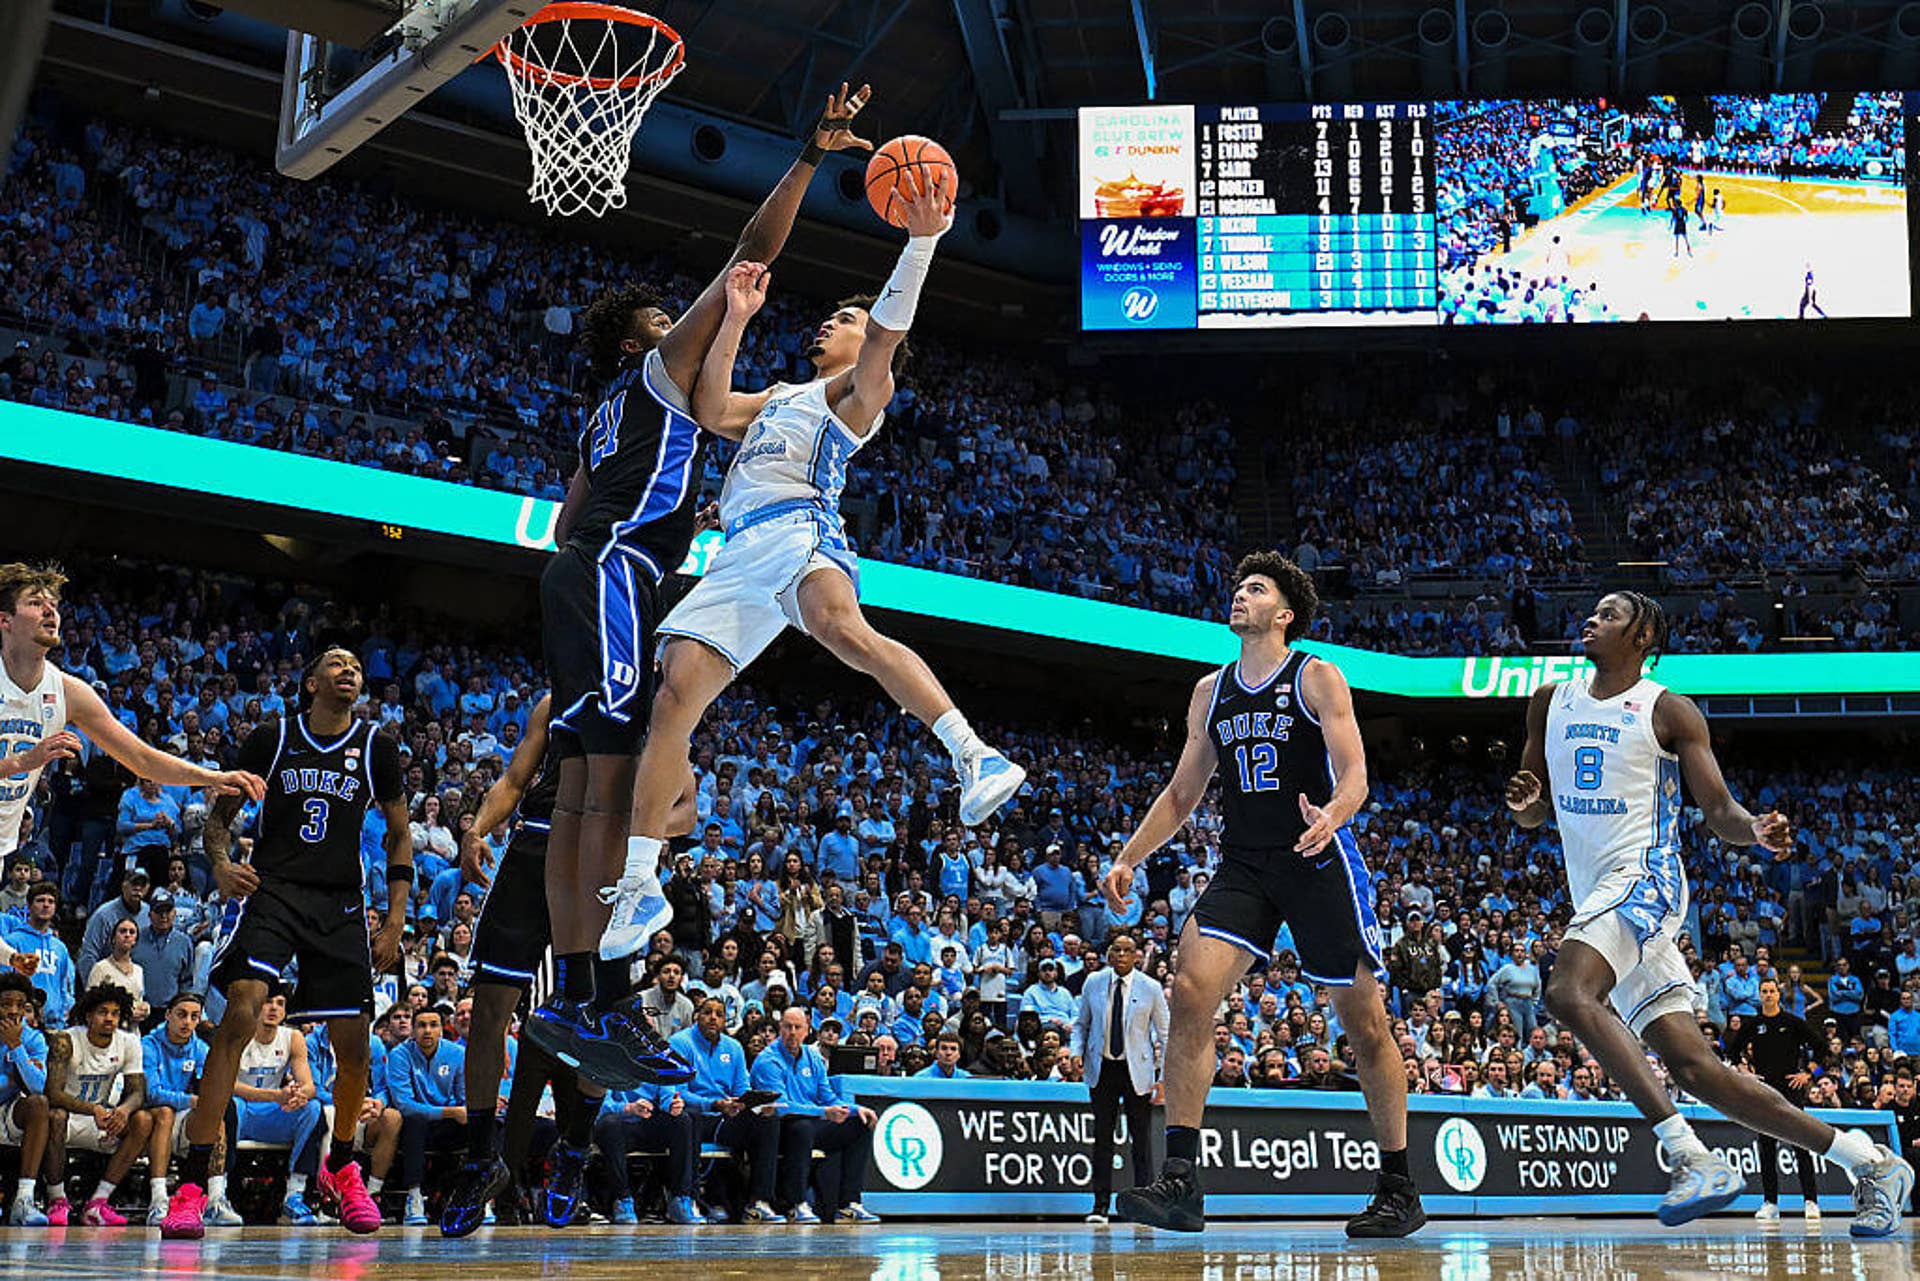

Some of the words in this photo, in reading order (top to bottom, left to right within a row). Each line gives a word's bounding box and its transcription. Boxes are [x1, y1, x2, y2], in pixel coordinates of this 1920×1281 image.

[1311, 104, 1332, 119] PTS
[1375, 104, 1396, 118] AST
[1407, 104, 1427, 118] FLS
[1316, 121, 1328, 139] 7
[1349, 121, 1358, 139] 1
[1380, 121, 1392, 138] 3
[1413, 120, 1421, 138] 1
[1201, 143, 1212, 160] 3
[1348, 141, 1360, 158] 0
[1201, 161, 1212, 178] 7
[1314, 159, 1332, 177] 13
[1381, 158, 1393, 175] 0
[1413, 157, 1422, 175] 1
[1318, 196, 1330, 214] 4
[1350, 196, 1360, 214] 7
[1383, 195, 1391, 213] 1
[1413, 195, 1425, 212] 3
[1203, 217, 1213, 233] 3
[1319, 215, 1330, 233] 0
[1352, 214, 1360, 232] 1
[1382, 214, 1394, 231] 0
[1415, 213, 1423, 230] 1
[1203, 235, 1213, 252] 7
[1352, 232, 1360, 250] 1
[1383, 232, 1394, 250] 0
[1413, 232, 1425, 250] 3
[1385, 250, 1392, 268] 1
[1416, 250, 1423, 268] 1
[1320, 271, 1332, 289] 0
[1351, 270, 1363, 288] 4
[1385, 269, 1393, 287] 1
[1416, 269, 1427, 287] 0
[1320, 290, 1331, 308] 3
[1353, 289, 1362, 308] 1
[1385, 288, 1393, 307] 1
[1417, 288, 1425, 306] 1
[1217, 712, 1294, 746] DUKE
[1565, 723, 1621, 744] NORTH
[1235, 742, 1280, 792] 12
[1575, 746, 1604, 790] 8
[281, 768, 361, 801] DUKE
[1558, 795, 1628, 814] CAROLINA
[300, 797, 329, 842] 3
[958, 1110, 1005, 1142] WE
[1496, 1124, 1531, 1152] WE
[1535, 1125, 1600, 1153] STAND
[1605, 1126, 1630, 1153] UP
[1196, 1128, 1223, 1168] R
[1232, 1130, 1318, 1179] Legal
[1324, 1131, 1381, 1171] Tea
[985, 1152, 1043, 1185] FOR
[1518, 1160, 1562, 1188] FOR
